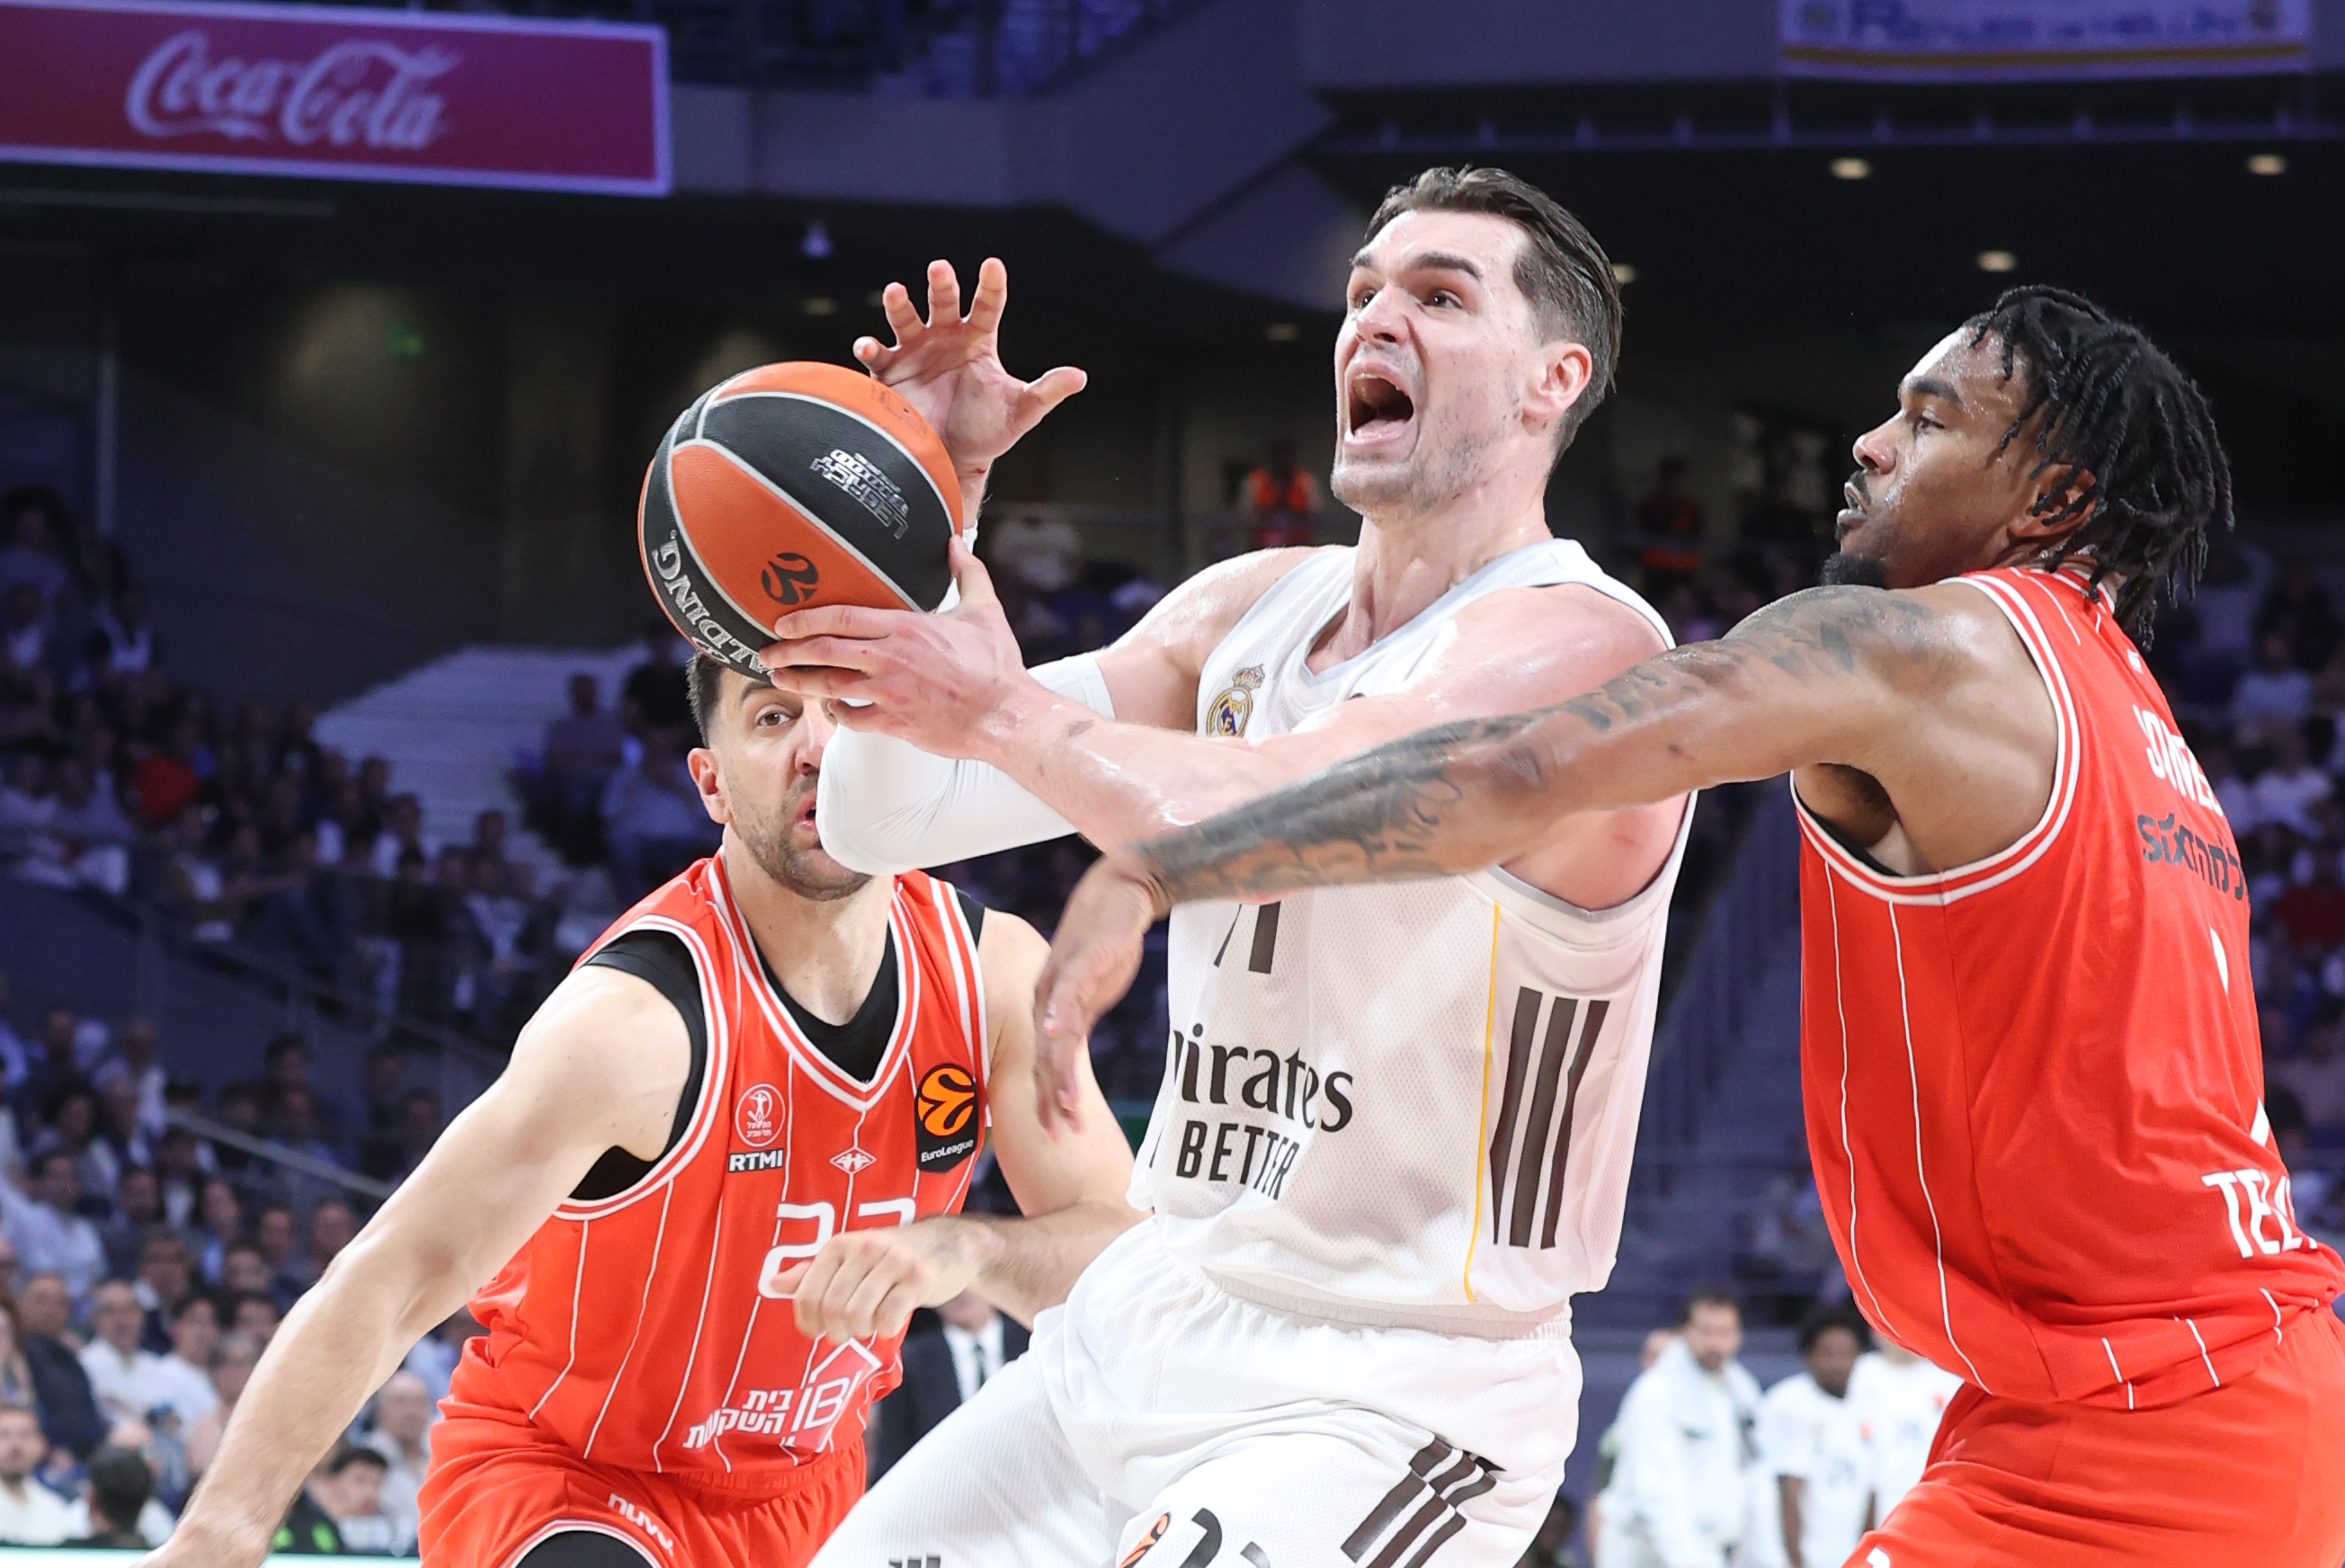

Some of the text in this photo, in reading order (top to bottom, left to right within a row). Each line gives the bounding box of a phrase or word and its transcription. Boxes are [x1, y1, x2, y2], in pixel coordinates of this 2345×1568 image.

[809, 455, 908, 539] LEGACY
[651, 539, 775, 677] ALDING
[1173, 1023, 1353, 1132] irates
[728, 1150, 783, 1172] RTMI
[921, 1138, 974, 1163] EuroLeague
[1176, 1120, 1300, 1201] BETTER
